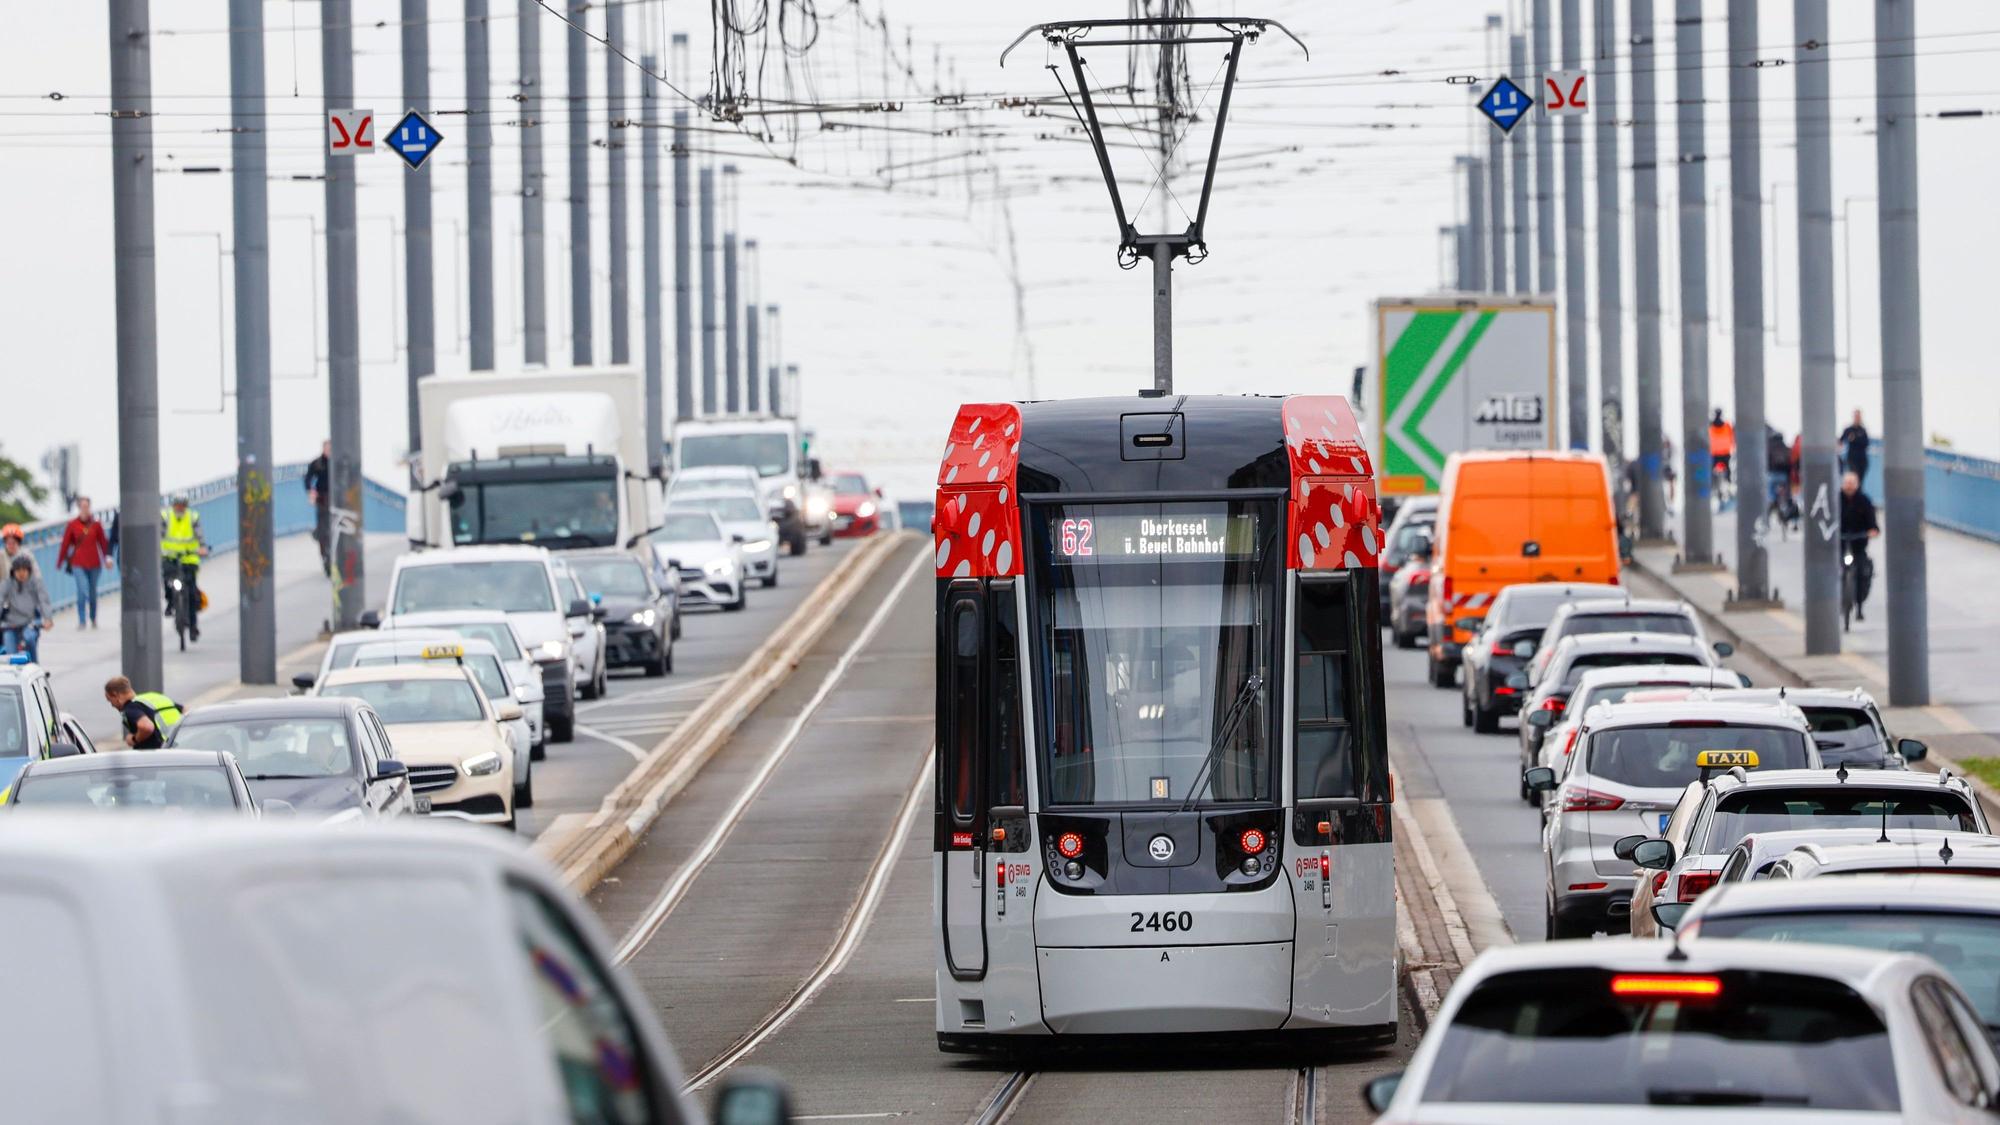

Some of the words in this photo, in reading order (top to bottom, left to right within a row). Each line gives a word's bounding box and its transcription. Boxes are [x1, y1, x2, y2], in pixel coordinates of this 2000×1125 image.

[1474, 395, 1542, 423] MTB
[1141, 519, 1208, 536] Oberkassel
[1062, 519, 1093, 556] 62
[1124, 537, 1136, 554] ü.
[1139, 538, 1173, 554] Beuel
[1176, 536, 1225, 554] Bahnhof
[429, 645, 457, 657] TAXI
[1708, 752, 1749, 764] TAXI
[1303, 857, 1319, 870] SWB
[1015, 864, 1031, 876] SWB
[1304, 880, 1315, 891] 2460
[1015, 887, 1026, 898] 2460
[1130, 910, 1193, 932] 2460
[1160, 951, 1170, 962] A
